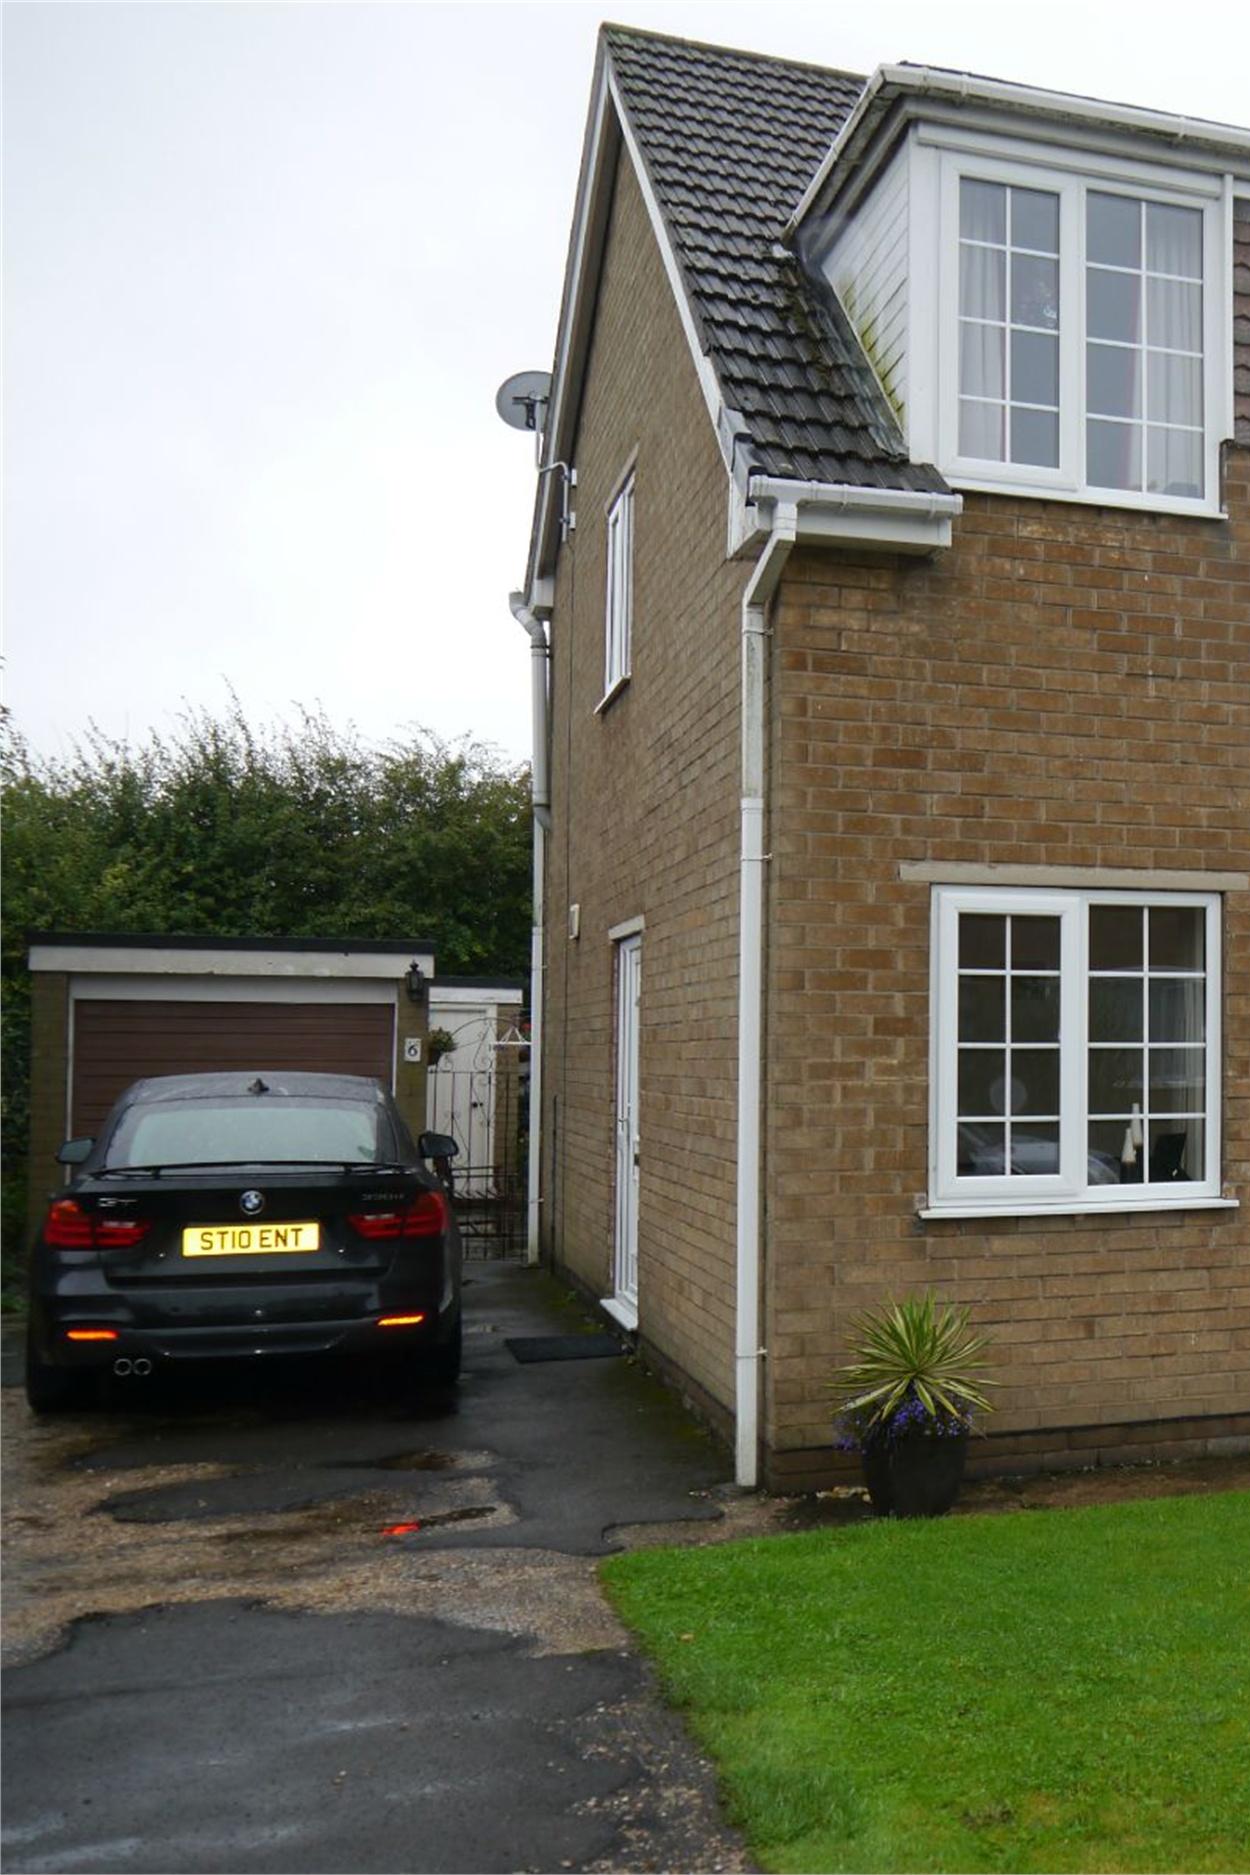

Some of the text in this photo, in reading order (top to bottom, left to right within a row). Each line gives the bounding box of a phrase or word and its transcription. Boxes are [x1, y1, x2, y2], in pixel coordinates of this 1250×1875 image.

[407, 1043, 418, 1057] 6
[200, 1227, 303, 1251] ST10 ENT
